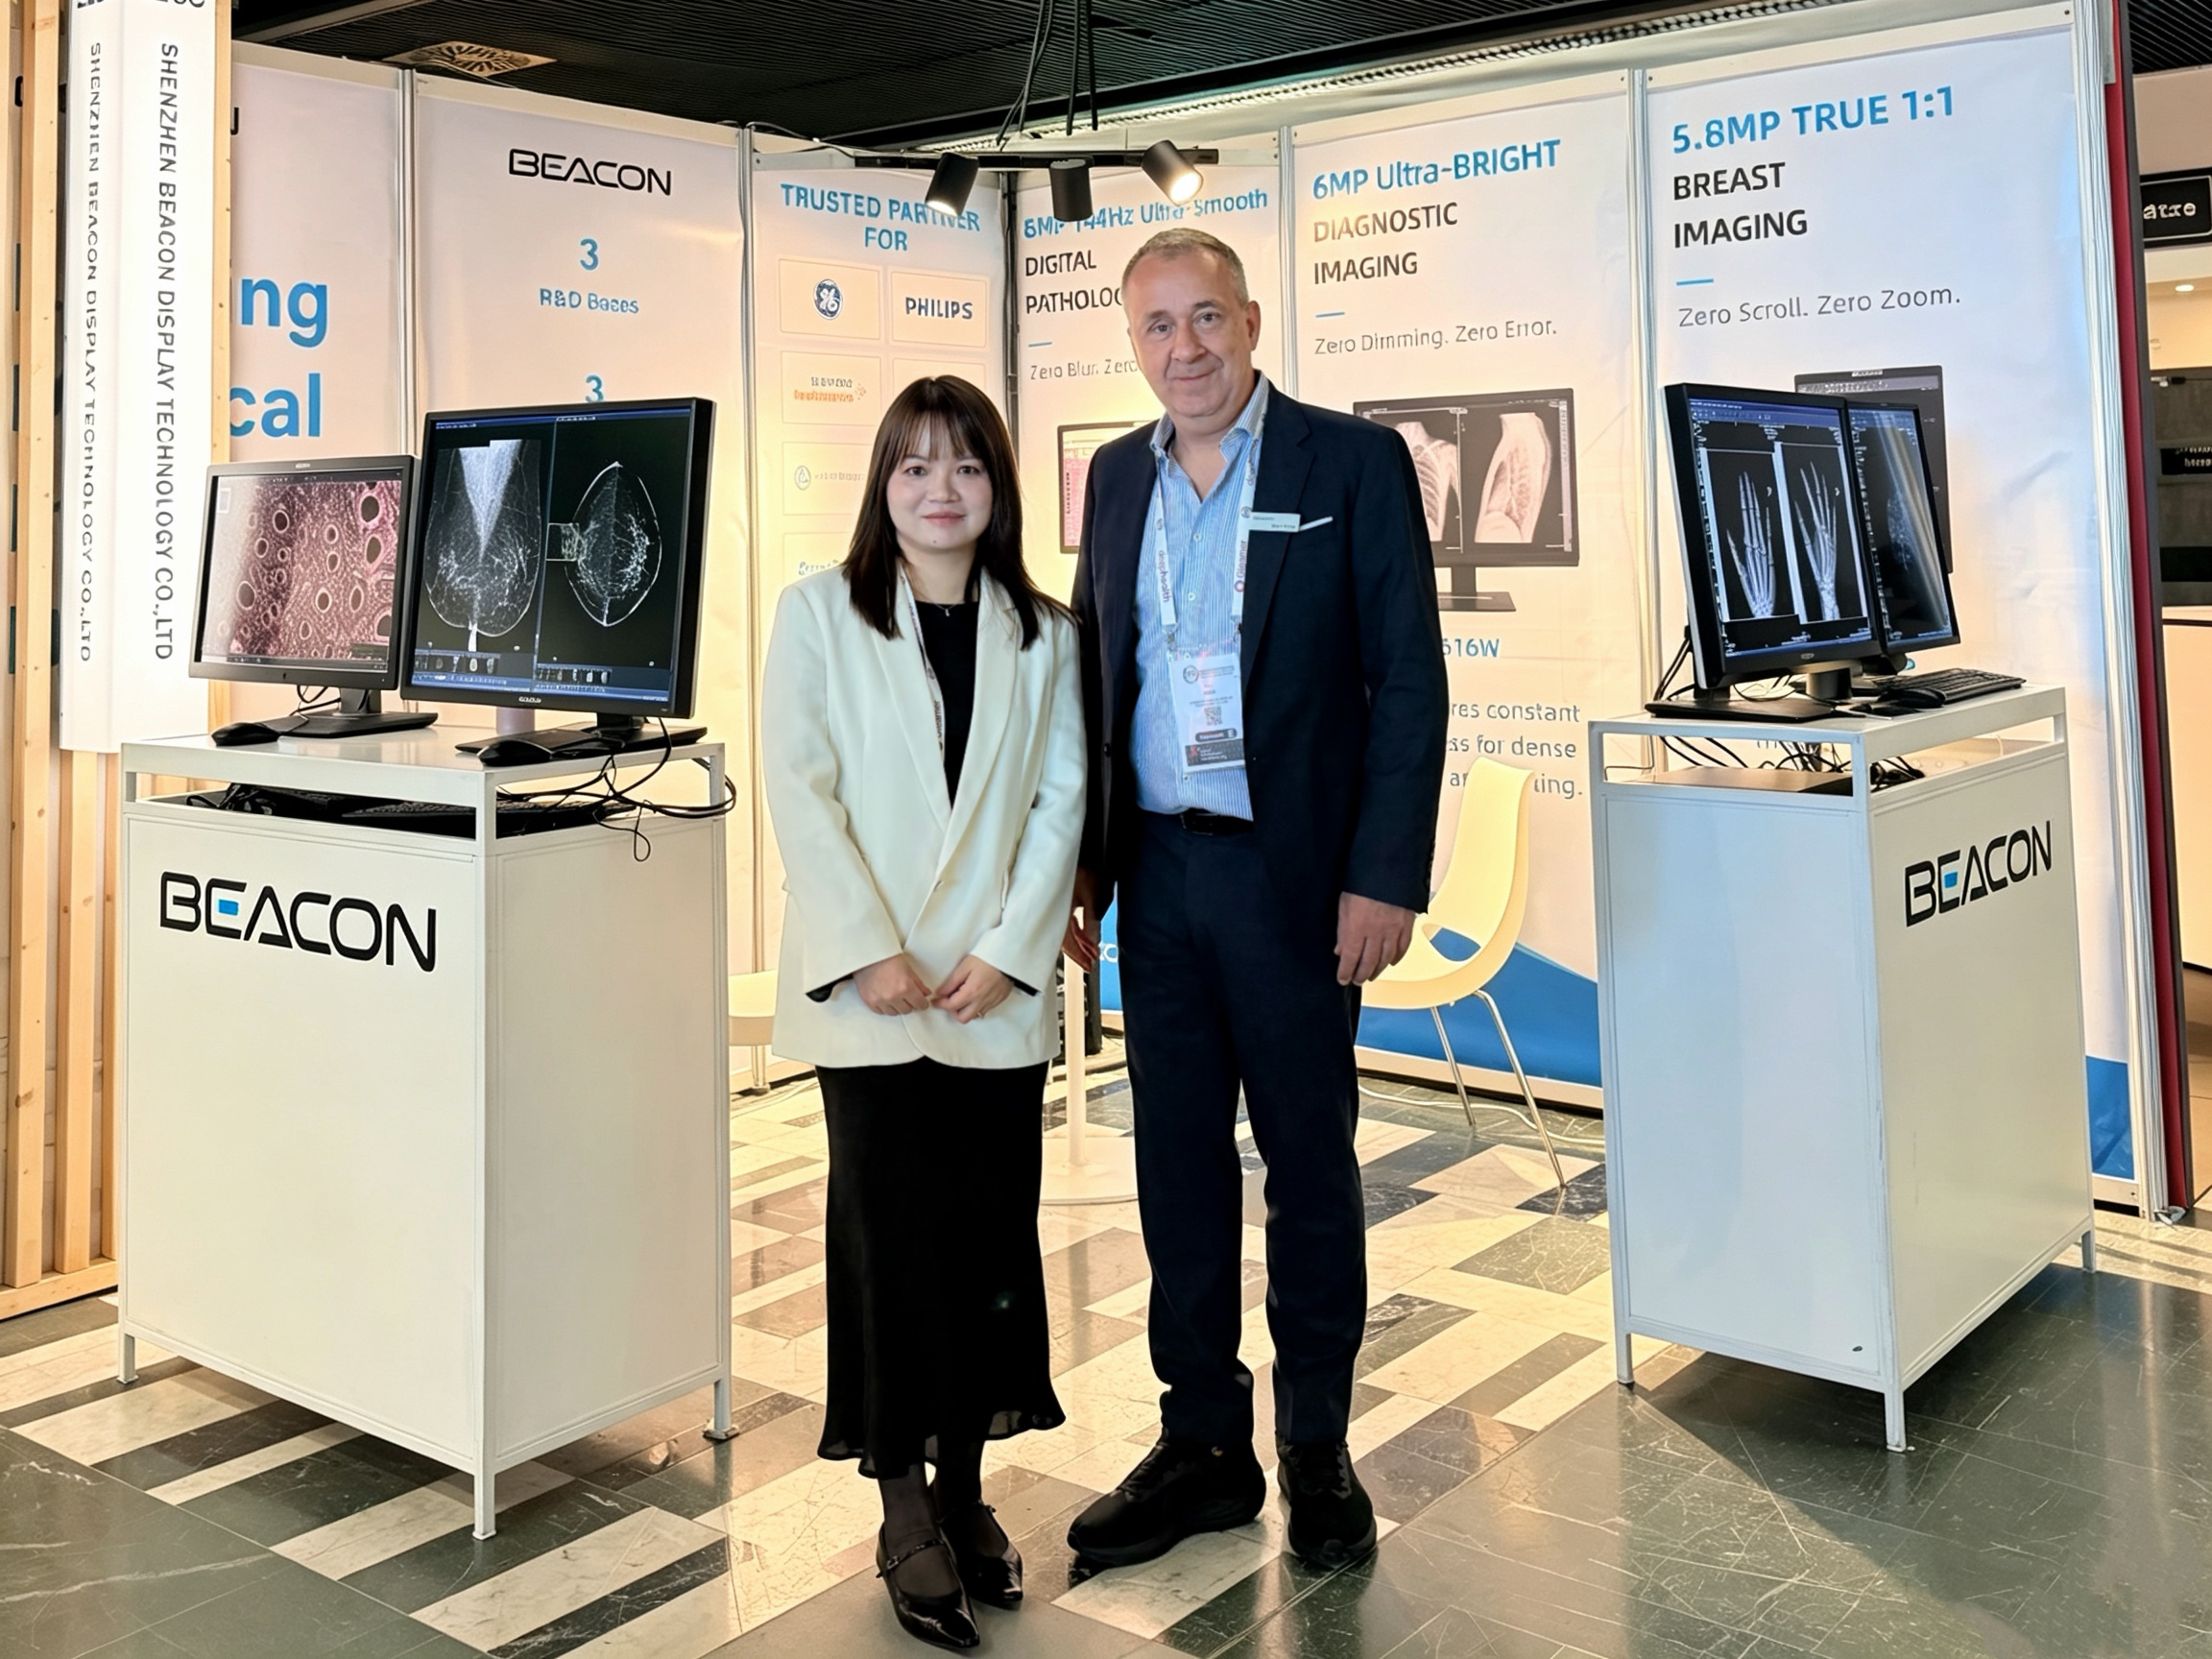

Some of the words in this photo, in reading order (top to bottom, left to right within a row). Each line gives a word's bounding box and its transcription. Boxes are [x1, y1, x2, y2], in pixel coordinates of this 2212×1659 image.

[89, 42, 101, 172] SHENZHEN
[158, 43, 179, 173] SHENZHEN
[1672, 110, 1781, 154] 5.8MP
[1791, 94, 1889, 135] TRUE
[1902, 85, 1953, 121] 1:1
[508, 148, 672, 197] BEACON
[1312, 168, 1369, 200] 6MP
[1376, 139, 1561, 190] Ultra-BRIGHT
[1673, 161, 1786, 201] BREAST
[780, 183, 881, 219] TRUSTED
[87, 181, 99, 280] BEACON
[157, 181, 177, 281] BEACON
[864, 227, 908, 252] FOR
[1312, 202, 1458, 243] DIAGNOSTIC
[1673, 208, 1809, 249] IMAGING
[579, 237, 600, 272] 3
[1024, 250, 1097, 276] DIGITAL
[1313, 252, 1419, 285] IMAGING
[540, 288, 583, 309] R&D
[904, 296, 974, 320] PHILIPS
[1678, 307, 1732, 328] Zero
[1739, 297, 1810, 323] Scroll.
[1817, 295, 1872, 316] Zero
[1881, 287, 1961, 310] Zoom.
[84, 290, 97, 392] DISPLAY
[156, 290, 176, 391] DISPLAY
[1314, 337, 1357, 355] Zero
[1361, 327, 1450, 349] Dimming.
[1455, 324, 1499, 343] Zero
[1504, 319, 1558, 339] Error.
[1030, 364, 1063, 380] Zero
[83, 398, 95, 563] TECHNOLOGY
[155, 397, 175, 560] TECHNOLOGY
[153, 566, 174, 661] CO.,LTD
[1487, 703, 1581, 723] constant
[1477, 733, 1505, 755] for
[1510, 735, 1577, 758] dense
[1905, 820, 2053, 928] BEACON
[159, 870, 438, 974] BEACON
